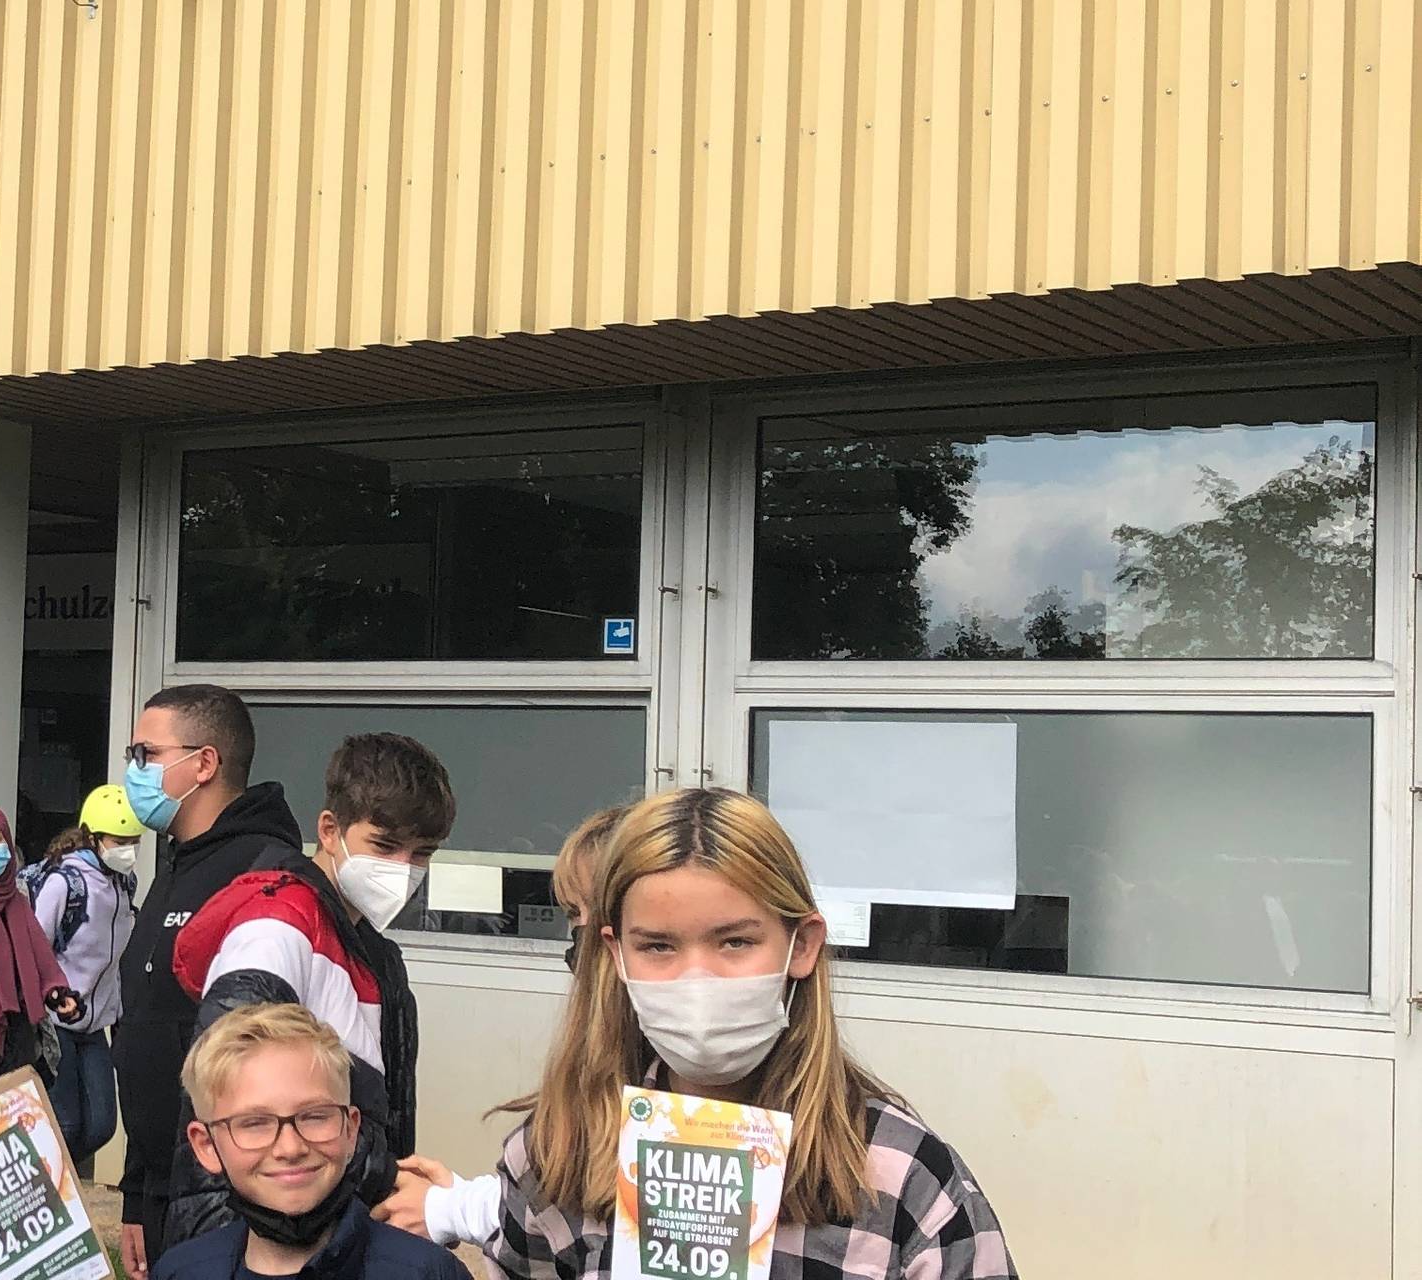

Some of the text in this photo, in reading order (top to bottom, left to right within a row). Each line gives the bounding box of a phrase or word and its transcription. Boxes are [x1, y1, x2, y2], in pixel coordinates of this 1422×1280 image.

[25, 584, 115, 619] chulz
[645, 1147, 744, 1187] KLIMA
[644, 1179, 743, 1216] STREIK
[647, 1217, 740, 1237] #FRIDAYSFORFUTURE
[658, 1208, 726, 1225] ZUSAMMEN MIT
[653, 1228, 732, 1247] AUF DIE STRASSEN
[647, 1239, 738, 1280] 24.09.
